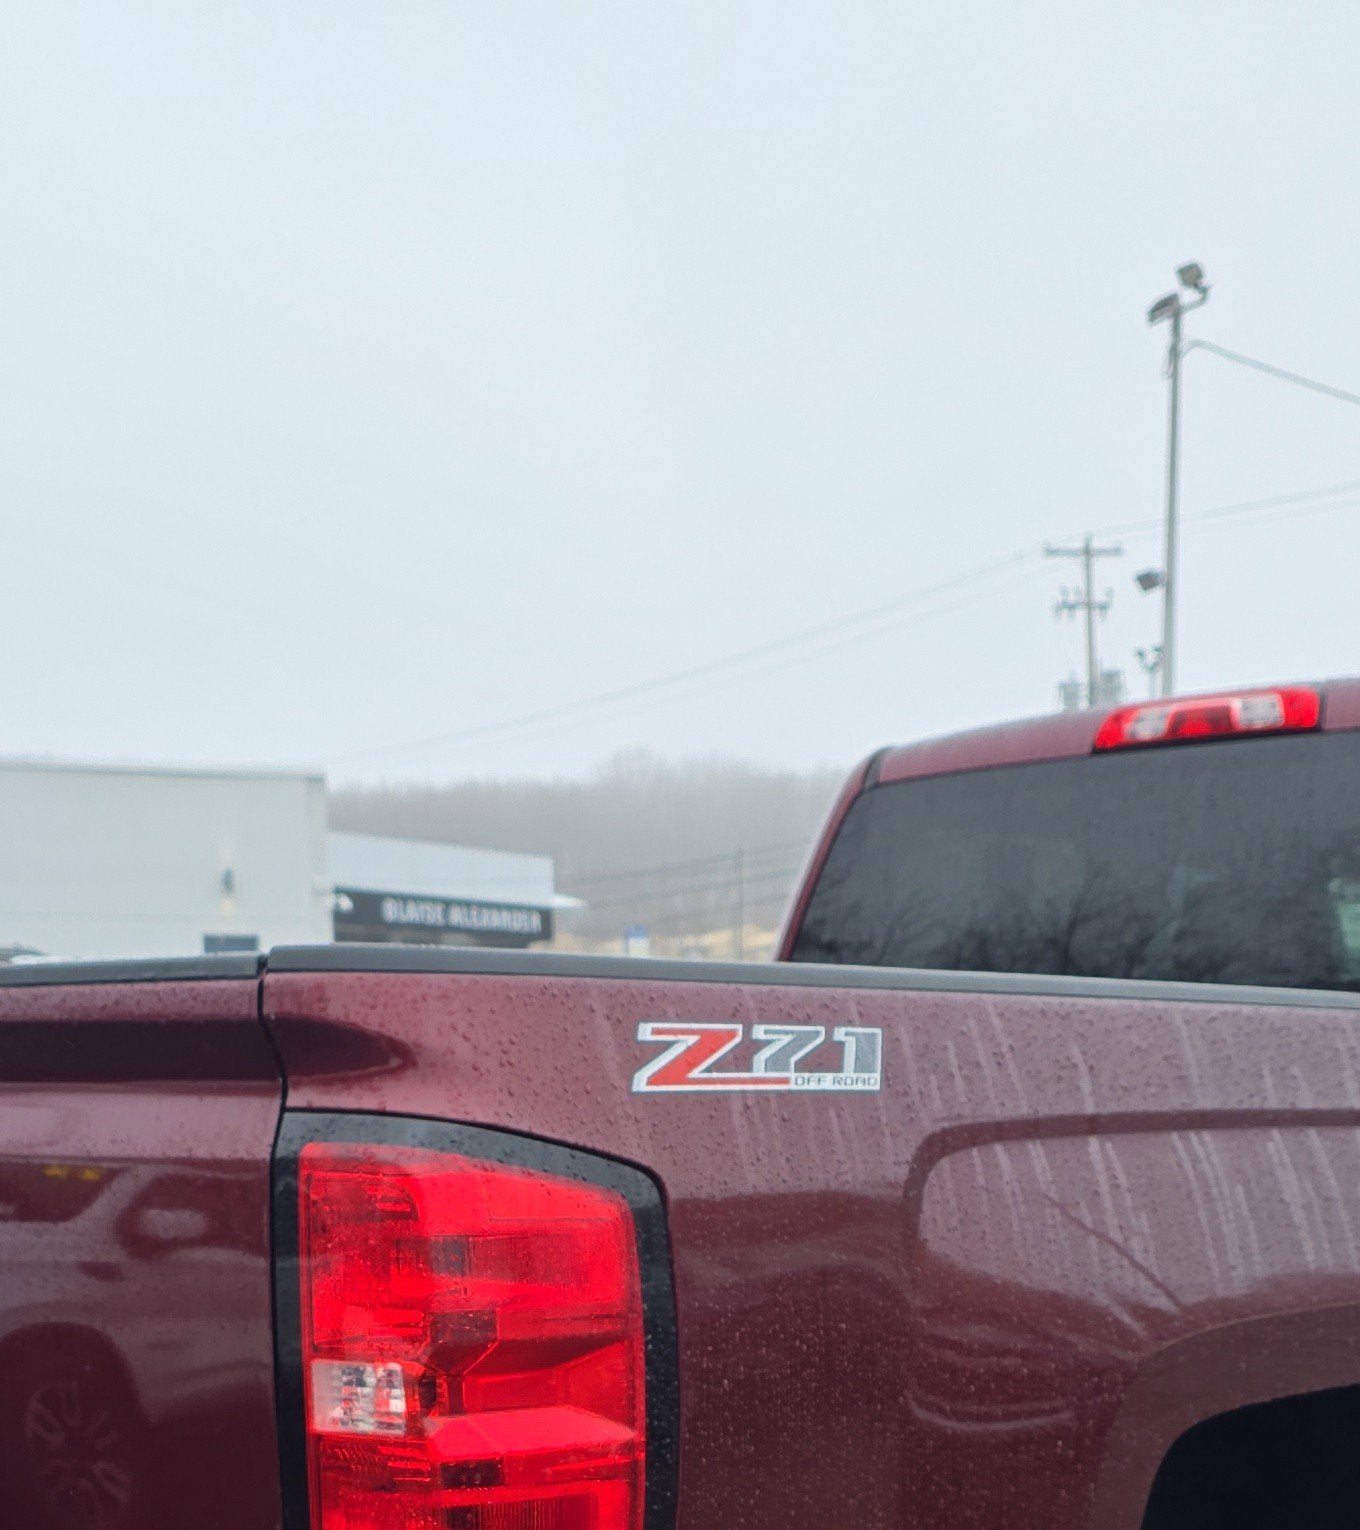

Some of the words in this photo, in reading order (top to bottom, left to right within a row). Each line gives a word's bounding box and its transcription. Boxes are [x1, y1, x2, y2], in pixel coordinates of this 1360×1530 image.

[632, 1022, 882, 1092] Z71
[794, 1075, 828, 1087] OFF
[832, 1075, 878, 1087] ROAD
